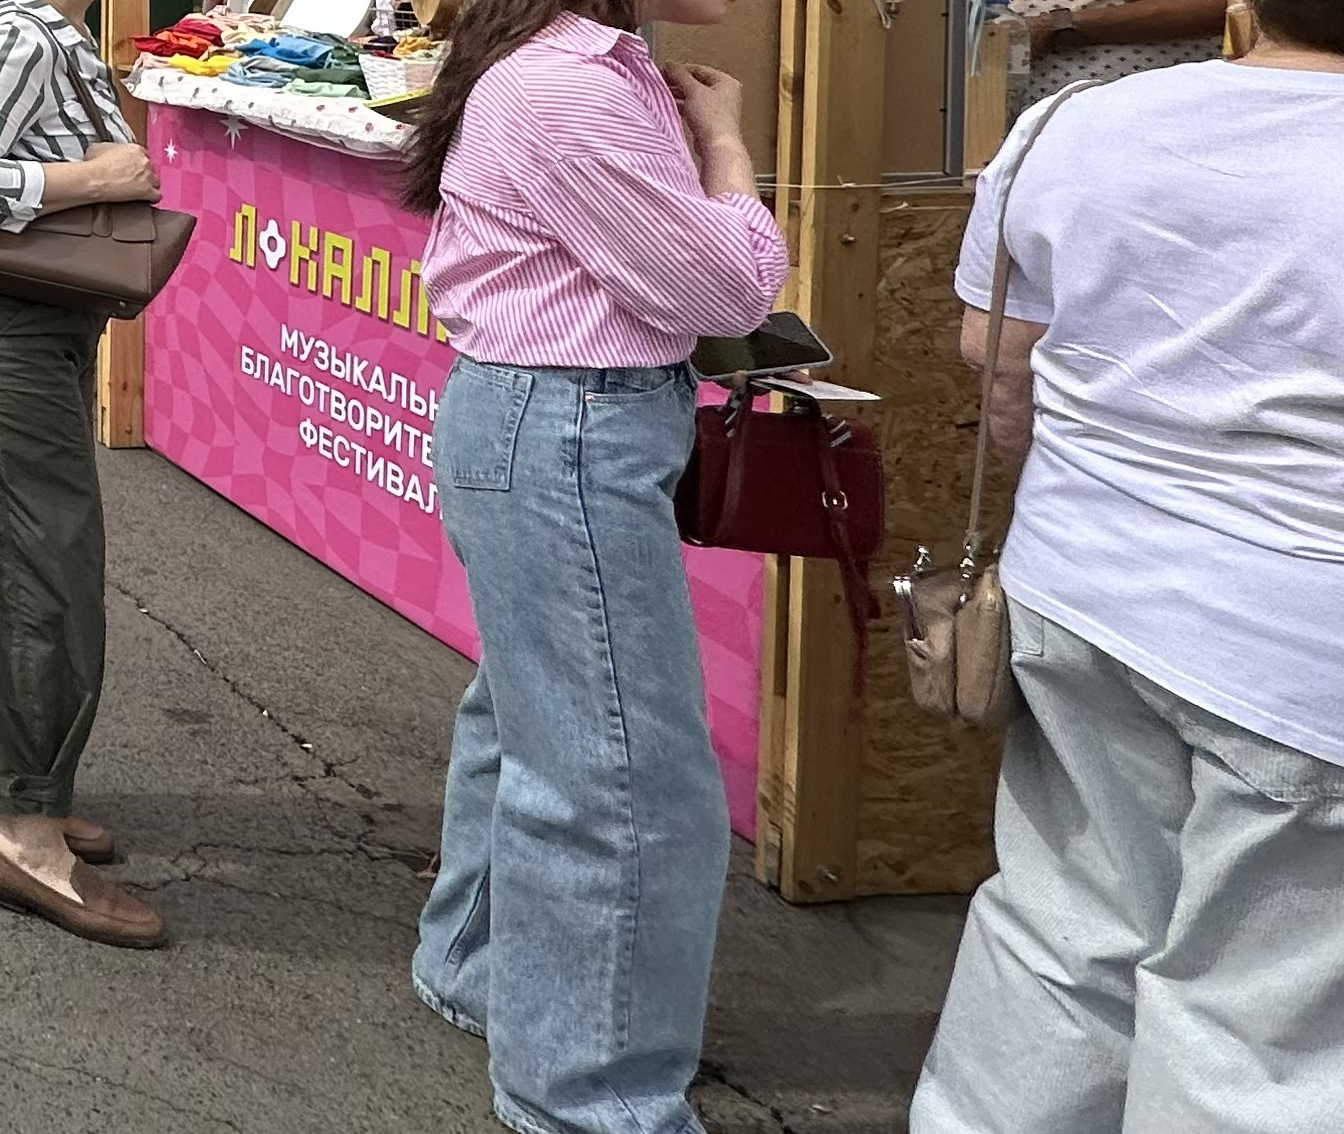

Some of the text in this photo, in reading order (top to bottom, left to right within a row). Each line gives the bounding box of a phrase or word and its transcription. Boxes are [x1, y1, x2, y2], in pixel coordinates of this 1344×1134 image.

[229, 203, 450, 343] ЛОКАЛЛ
[241, 346, 433, 468] БЛАГОТВОРИТЕ
[299, 417, 443, 520] ФЕСТИВАЛ
